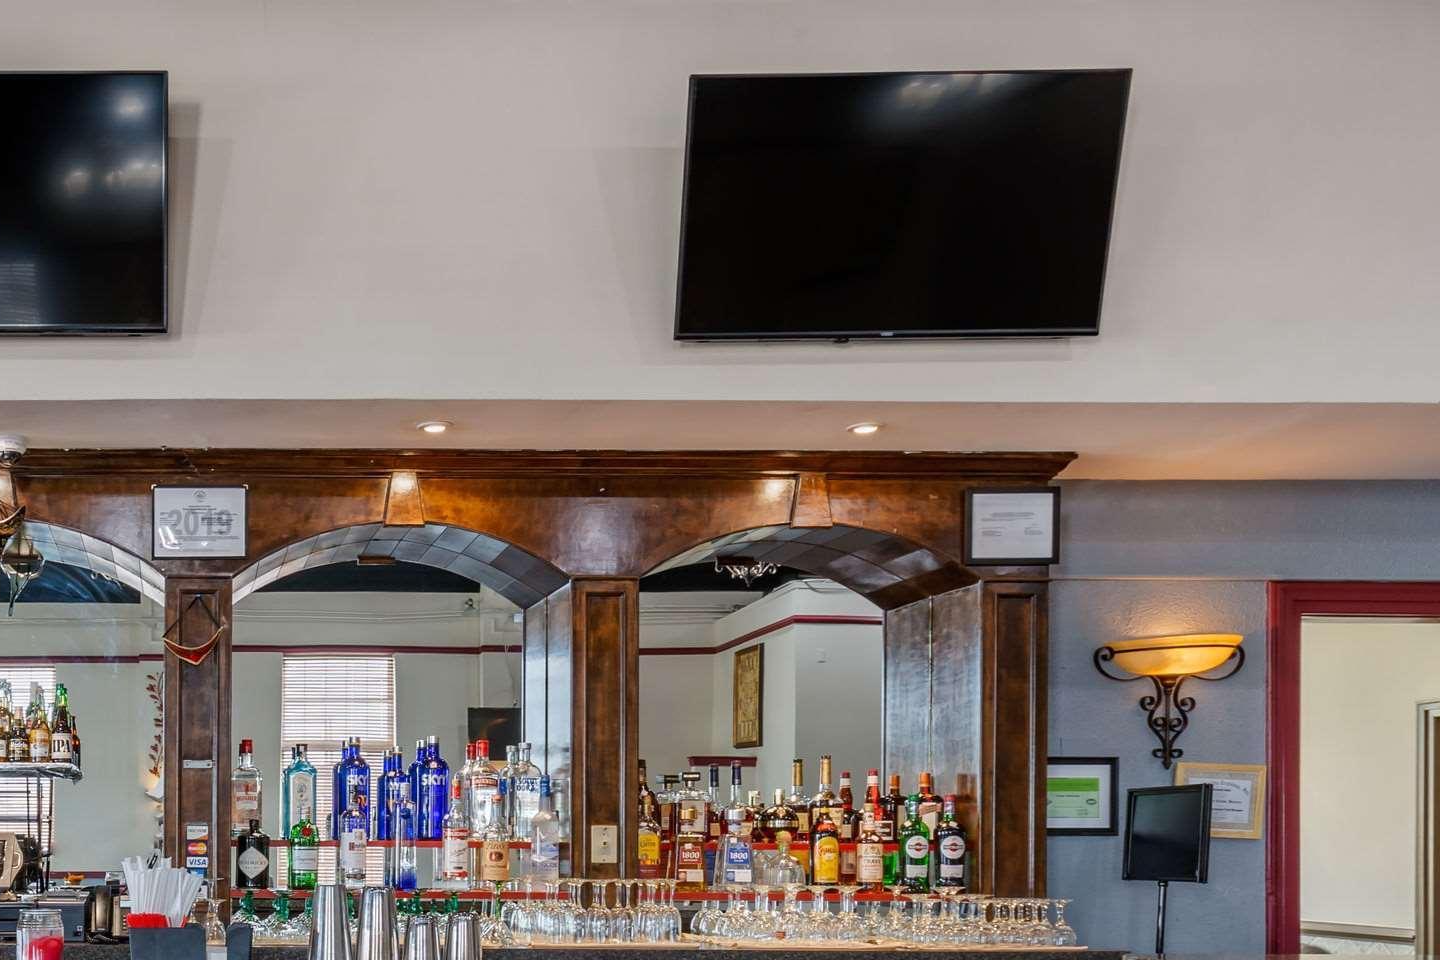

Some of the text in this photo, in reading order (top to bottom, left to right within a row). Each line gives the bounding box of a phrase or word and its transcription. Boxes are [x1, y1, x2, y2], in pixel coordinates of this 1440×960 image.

[53, 739, 71, 753] IPA
[682, 851, 700, 859] 1800
[729, 851, 748, 860] 1800
[189, 858, 207, 866] VISA
